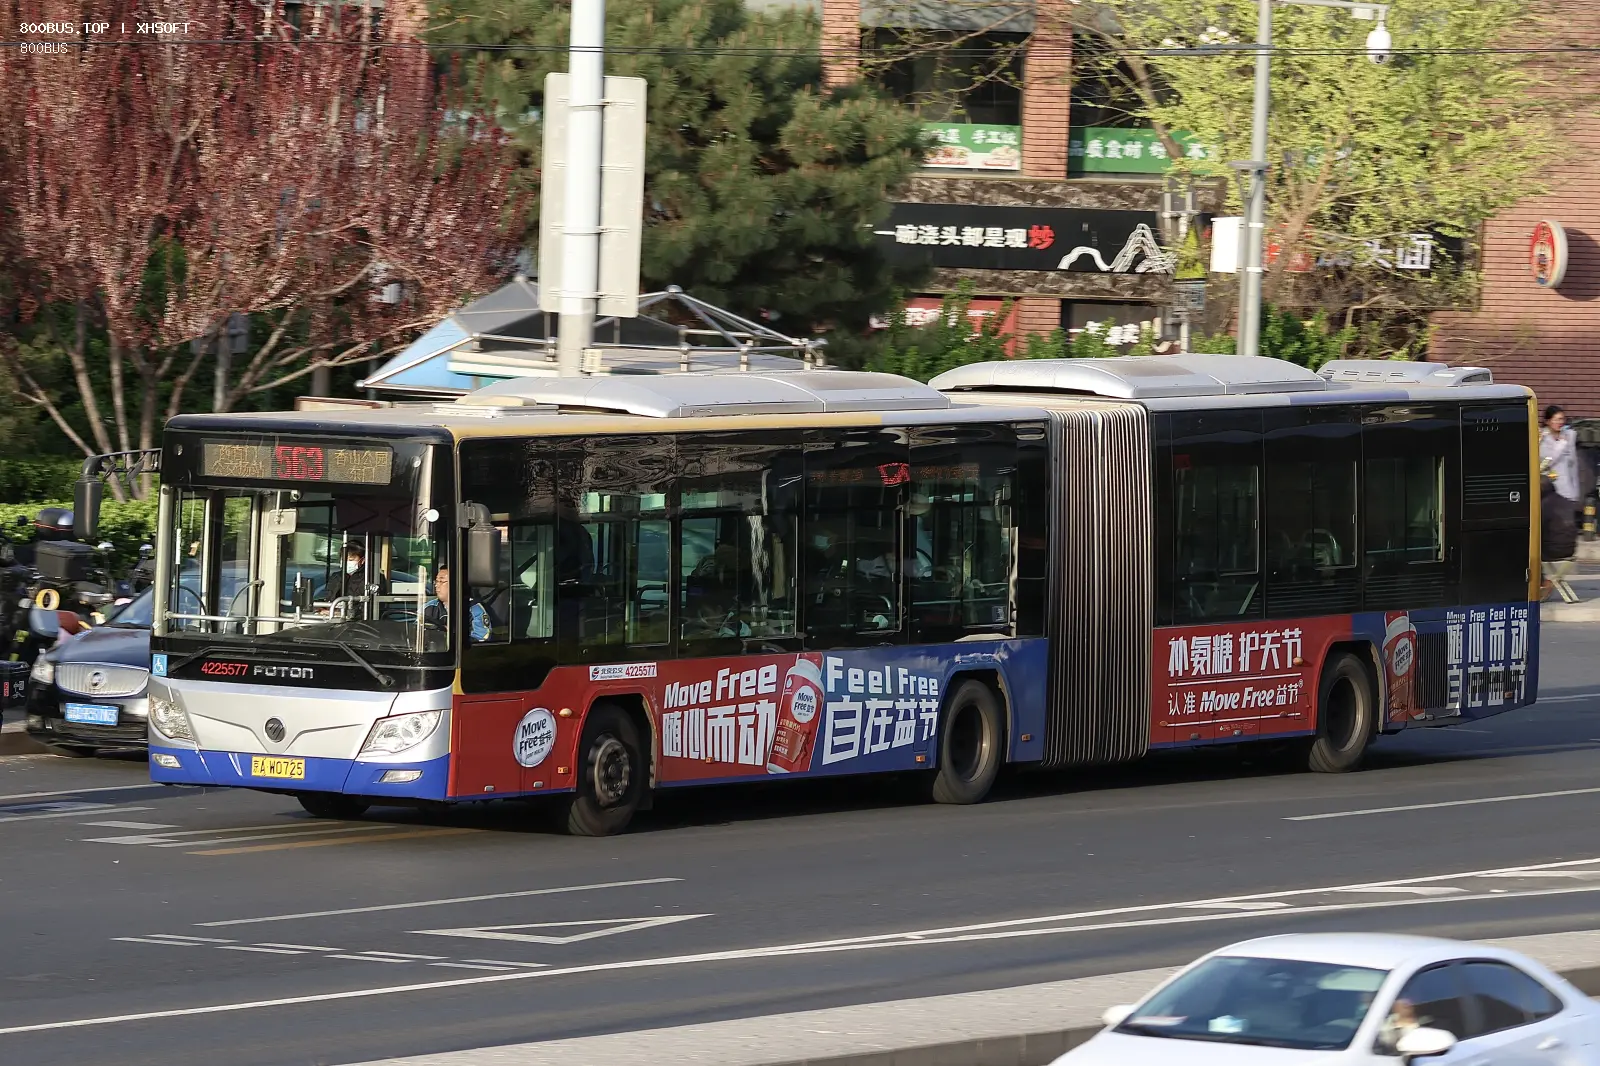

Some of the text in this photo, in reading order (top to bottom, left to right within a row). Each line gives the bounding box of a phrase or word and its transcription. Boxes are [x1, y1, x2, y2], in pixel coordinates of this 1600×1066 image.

[275, 445, 324, 481] 563
[334, 449, 388, 467] 香山公园
[1446, 606, 1528, 624] Move Free Feel Free
[1168, 627, 1302, 677] 补氨糖 护关节
[201, 662, 249, 676] 4225577
[253, 665, 314, 679] FOTON
[625, 665, 656, 677] 4225577
[826, 656, 939, 696] Feel Free
[663, 663, 778, 710] Move Free
[793, 702, 807, 711] Free
[797, 692, 814, 703] Move
[1168, 691, 1196, 716] 认准
[1199, 690, 1239, 713] Move
[1240, 686, 1274, 709] Free
[521, 718, 547, 739] Move
[662, 698, 777, 766] 随心而动
[821, 694, 940, 766] 自在益节
[519, 735, 538, 755] Free
